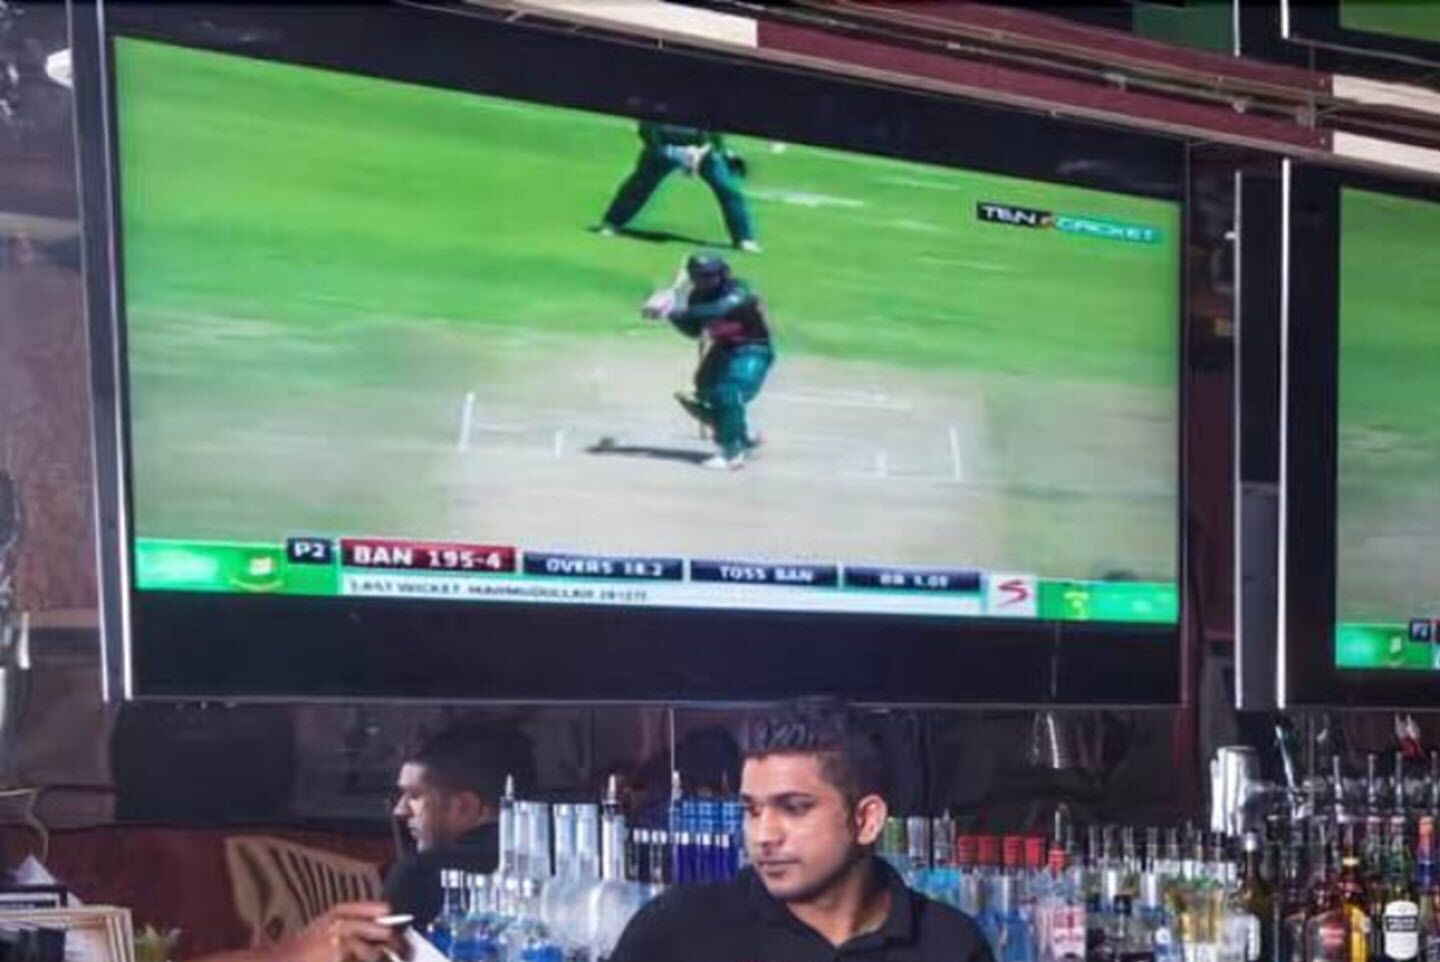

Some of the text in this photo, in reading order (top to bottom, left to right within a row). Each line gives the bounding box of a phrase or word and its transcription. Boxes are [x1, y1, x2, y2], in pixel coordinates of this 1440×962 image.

[981, 205, 1036, 225] TEN
[294, 542, 326, 559] P2
[352, 545, 502, 570] BAN 195-4
[546, 557, 613, 576] OVERS
[720, 565, 814, 582] TOSS BAN
